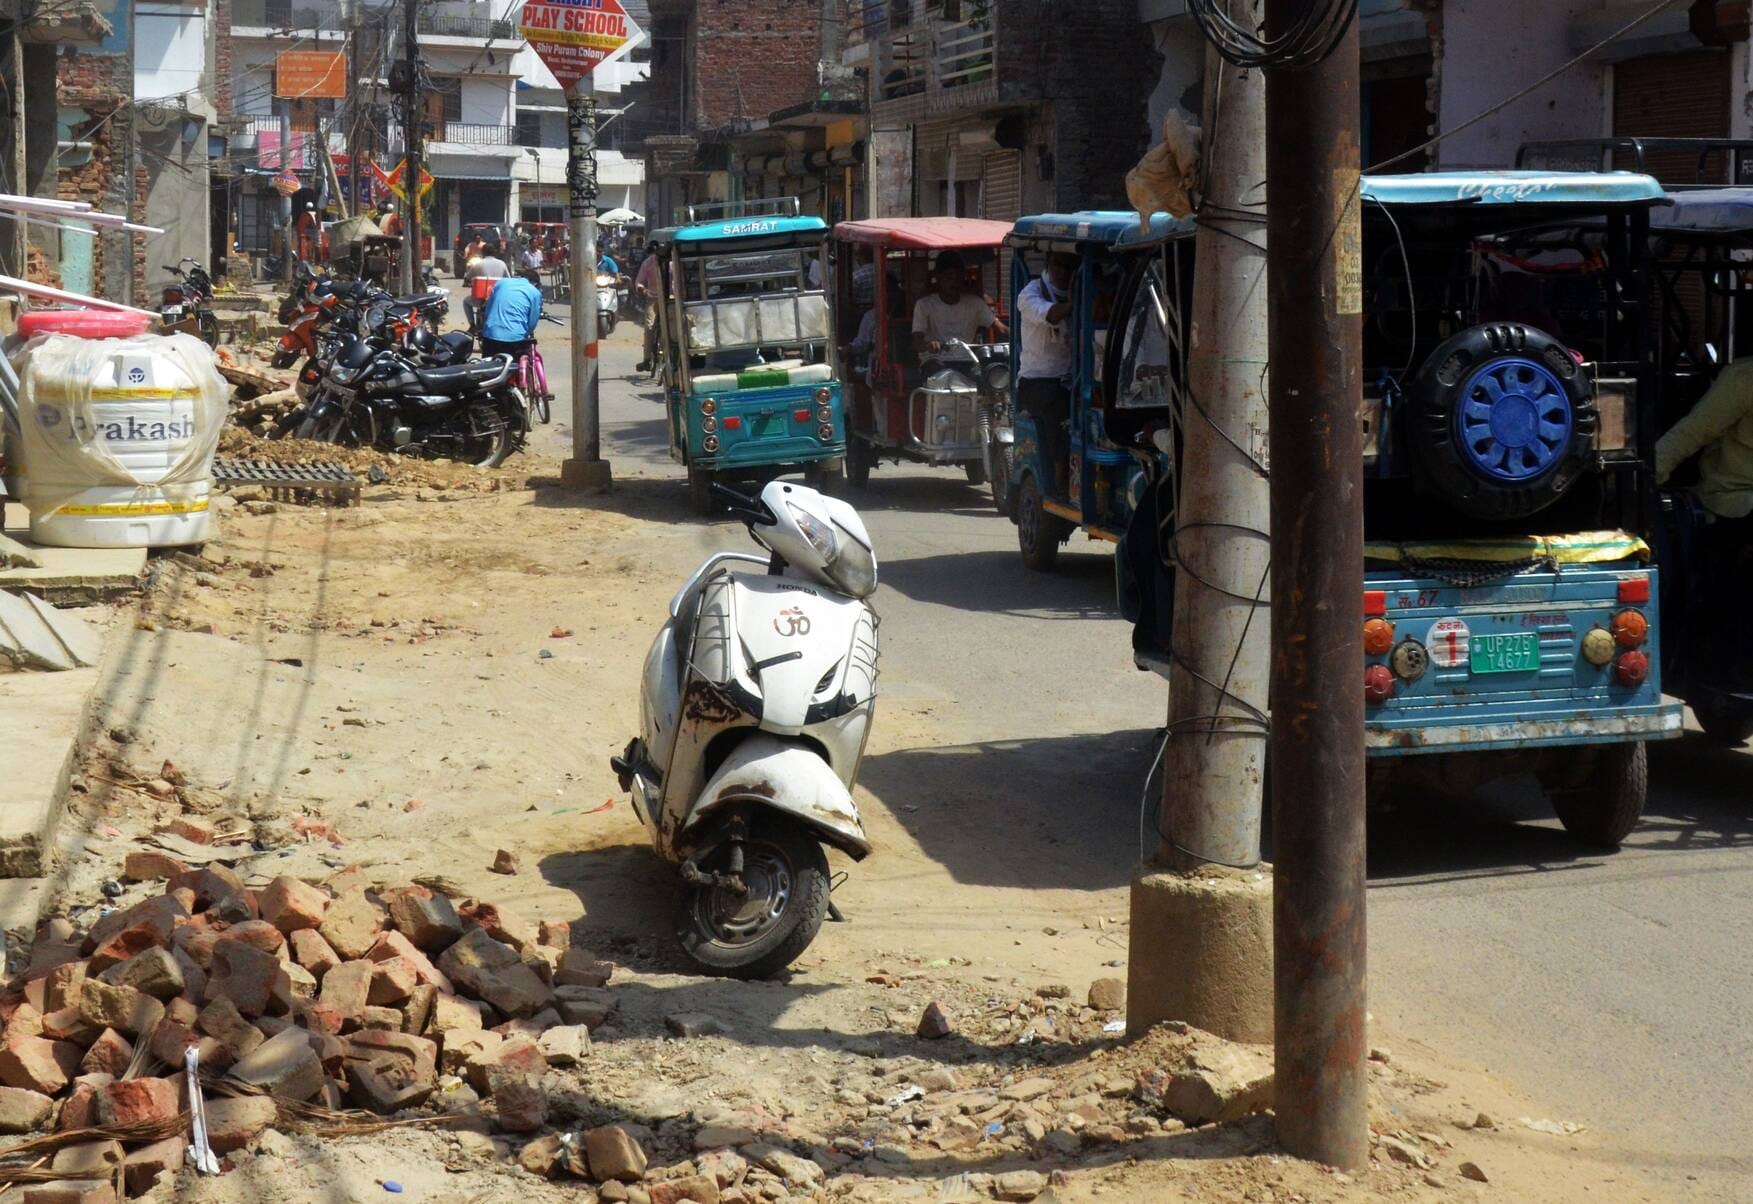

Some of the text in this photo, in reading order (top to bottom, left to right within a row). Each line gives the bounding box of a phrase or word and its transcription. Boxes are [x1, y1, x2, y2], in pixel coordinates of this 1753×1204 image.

[521, 6, 628, 37] PLAY SCHOOL
[536, 42, 606, 60] Shiv Puram Colony
[722, 221, 778, 235] SAMRAT
[68, 415, 197, 442] Prakash
[776, 583, 818, 597] HONDA
[1445, 631, 1457, 664] 1
[1486, 635, 1530, 653] UP27B
[1487, 651, 1531, 669] T4677
